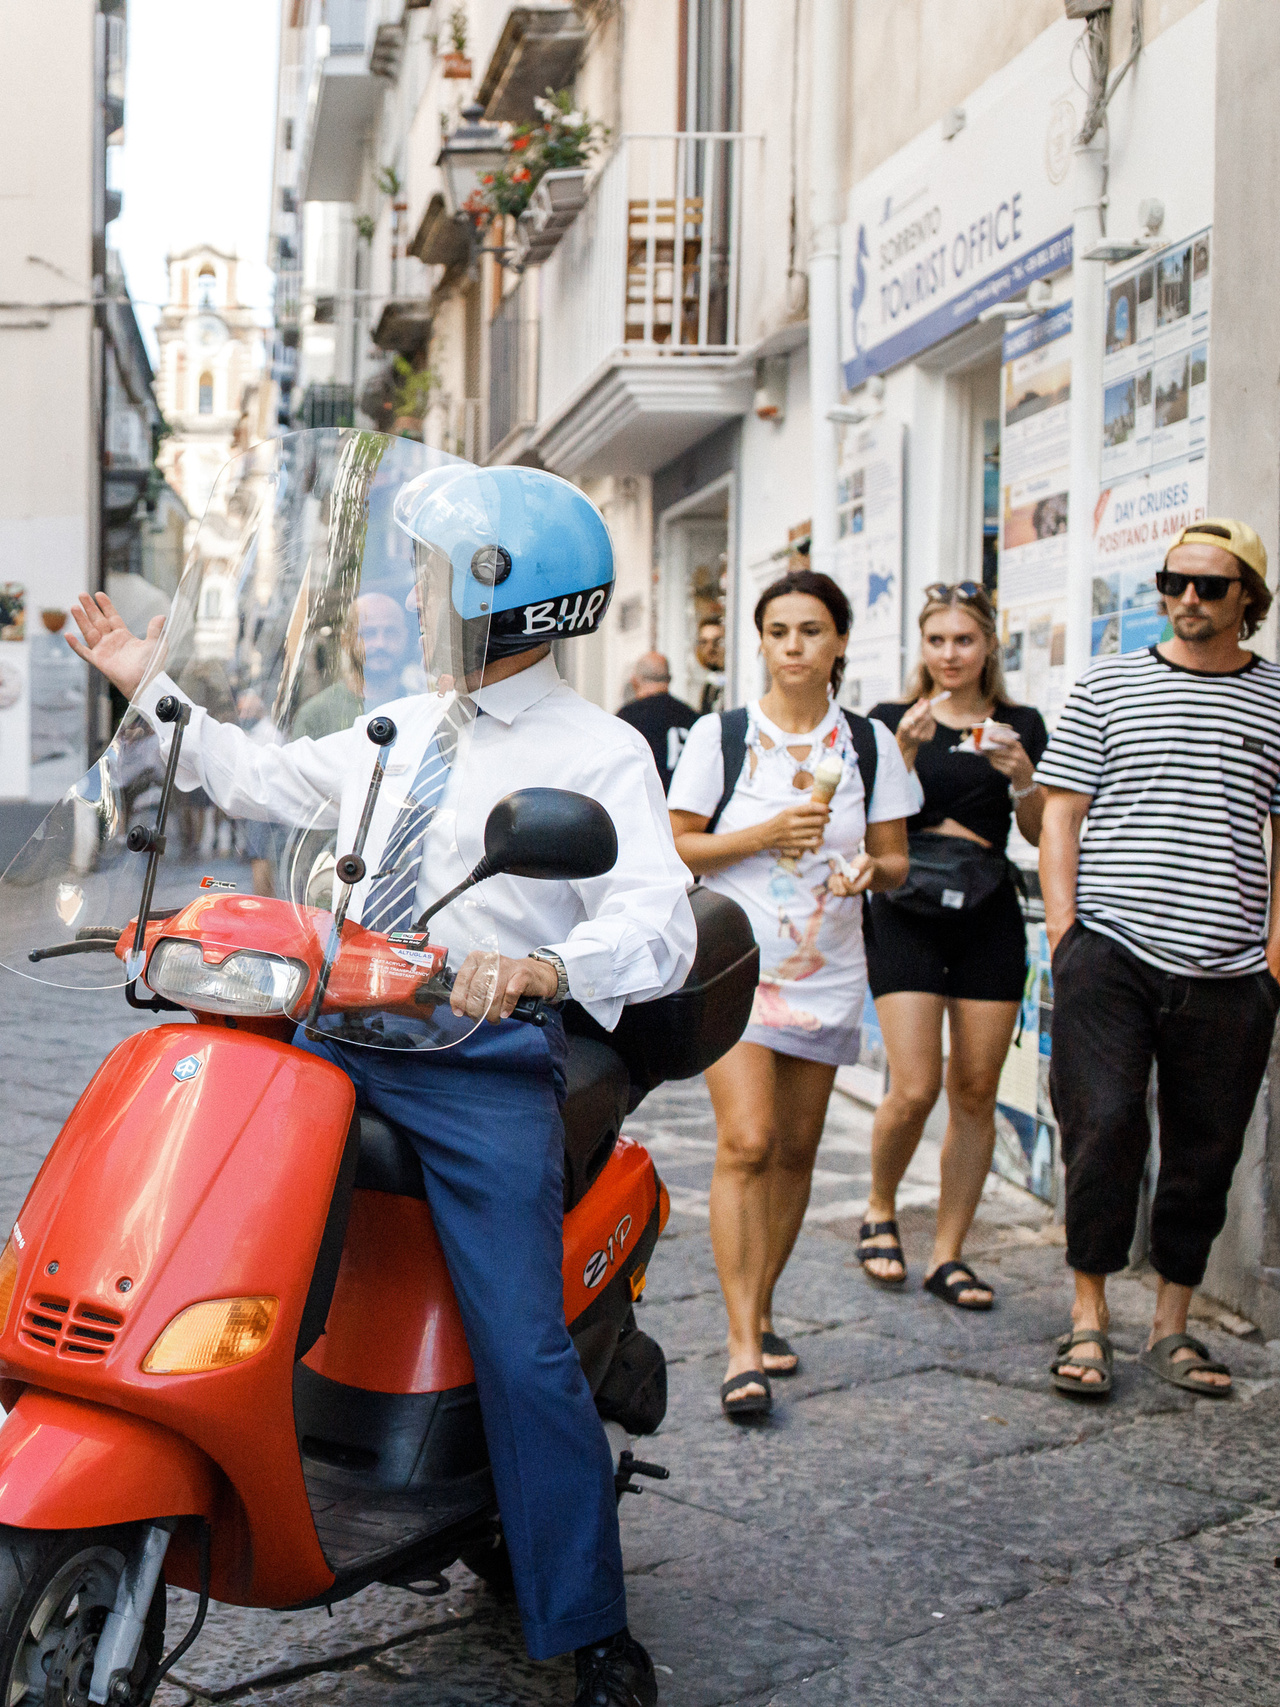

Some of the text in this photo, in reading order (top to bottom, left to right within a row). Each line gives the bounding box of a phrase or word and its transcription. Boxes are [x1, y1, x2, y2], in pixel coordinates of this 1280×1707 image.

[880, 192, 1021, 325] TOURIST OFFICE
[1115, 481, 1189, 523] DAY CRUISES
[1099, 523, 1149, 553] POSITANO
[522, 589, 606, 635] BHR
[385, 959, 407, 968] ACRYLIC
[398, 949, 432, 959] ALTUGLAS
